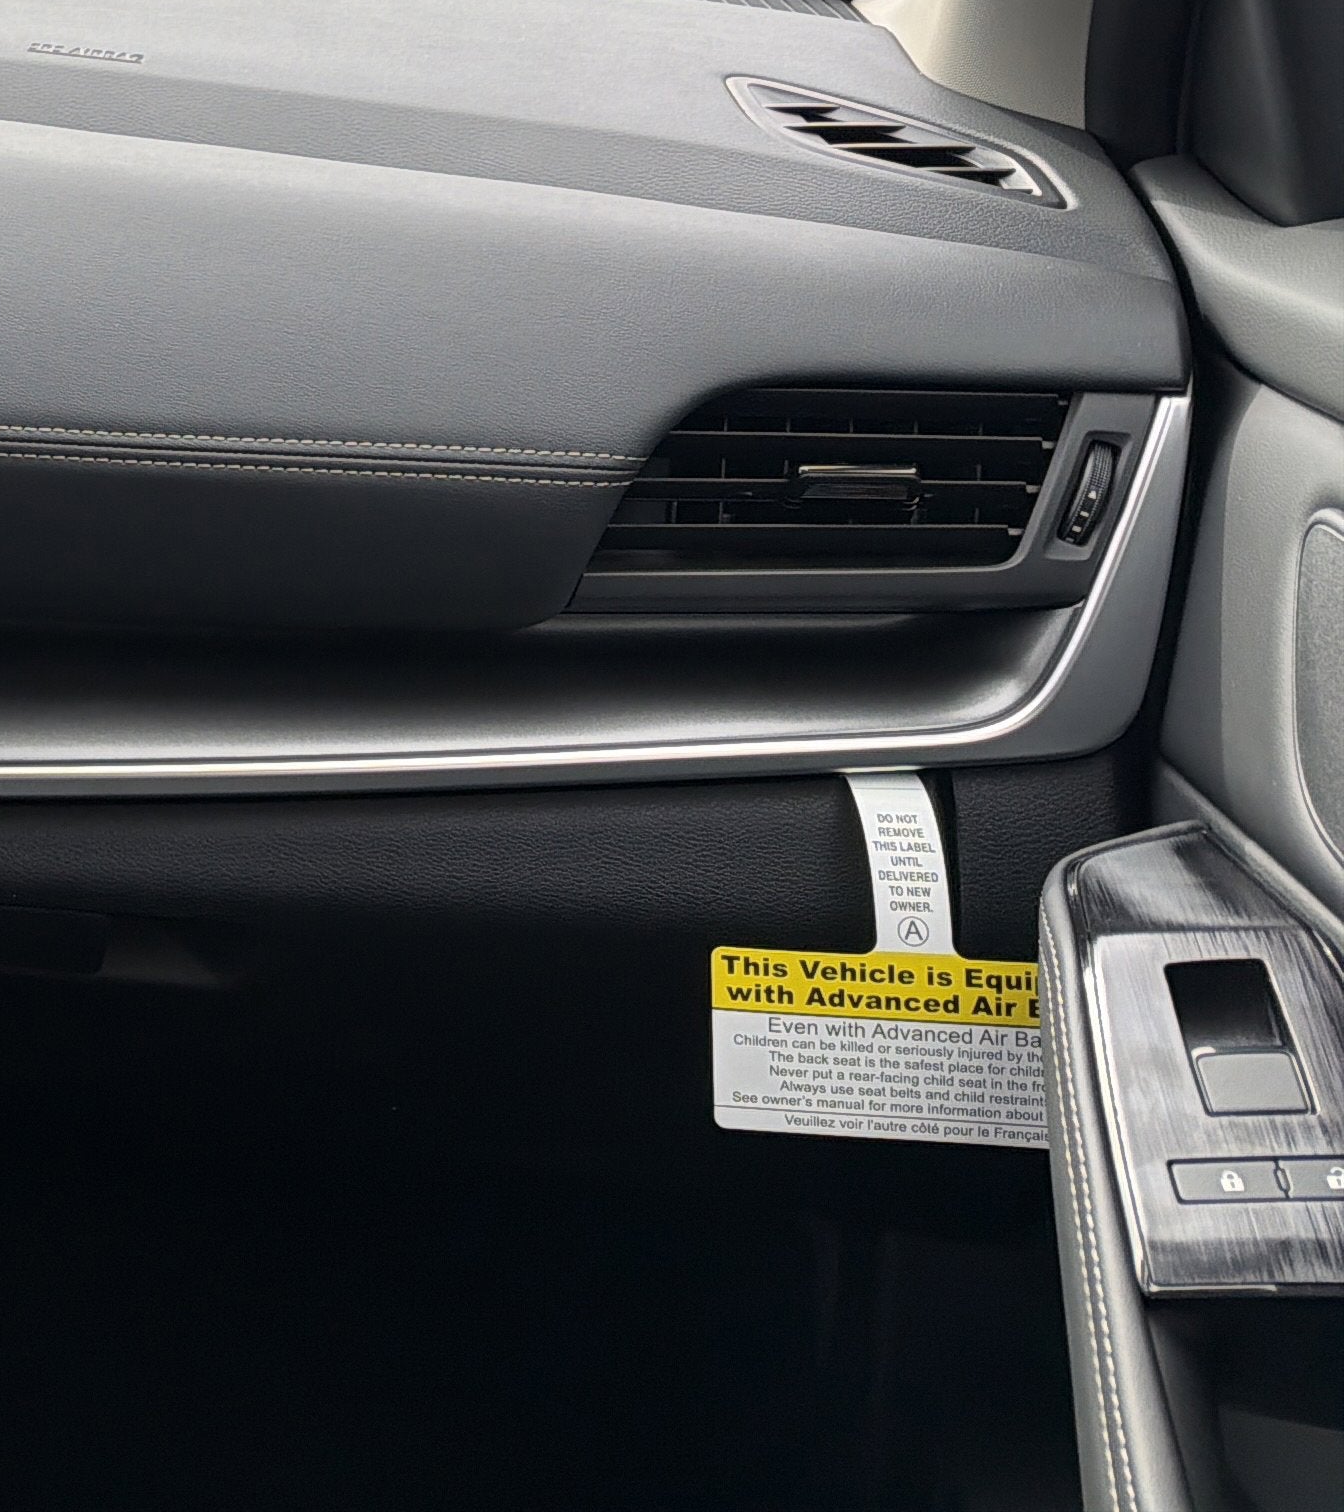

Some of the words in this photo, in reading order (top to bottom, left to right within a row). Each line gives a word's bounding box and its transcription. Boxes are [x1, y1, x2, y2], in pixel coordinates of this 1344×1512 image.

[876, 813, 893, 824] DO
[895, 814, 918, 825] NOT
[878, 827, 925, 839] REMOVE
[873, 840, 898, 852] THIS
[899, 841, 937, 854] LABEL
[890, 856, 923, 868] UNTIL
[878, 870, 939, 883] DELIVERED
[889, 885, 904, 897] TO
[906, 886, 932, 898] NEW
[889, 900, 934, 913] OWNER.
[904, 920, 924, 941] A
[721, 954, 789, 978] This
[799, 959, 916, 985] Vehicle
[927, 966, 953, 987] is
[726, 983, 794, 1005] with
[805, 987, 960, 1015] Advanced
[971, 996, 1018, 1017] Air
[768, 1016, 819, 1036] Even
[825, 1021, 866, 1039] with
[872, 1023, 973, 1045] Advanced
[979, 1029, 1009, 1047] Air
[733, 1033, 788, 1048] Children
[791, 1039, 816, 1050] can
[819, 1040, 837, 1051] be
[840, 1040, 874, 1054] killed
[877, 1044, 892, 1054] or
[895, 1045, 955, 1061] seriously
[957, 1048, 1003, 1062] injured
[1007, 1049, 1024, 1065] by
[769, 1050, 795, 1064] The
[798, 1052, 830, 1066] back
[832, 1055, 862, 1068] seat
[864, 1057, 876, 1069] is
[879, 1058, 901, 1070] the
[904, 1059, 945, 1072] safest
[948, 1063, 984, 1075] place
[987, 1063, 1007, 1076] for
[769, 1065, 809, 1078] Never
[812, 1069, 833, 1082] put
[836, 1071, 845, 1081] a
[848, 1072, 920, 1088] rear-facing
[923, 1075, 955, 1087] child
[958, 1078, 987, 1089] seat
[990, 1079, 1003, 1090] in
[1006, 1080, 1028, 1092] the
[780, 1080, 827, 1096] Always
[830, 1086, 854, 1096] use
[858, 1086, 887, 1098] seat
[890, 1088, 922, 1099] belts
[925, 1090, 950, 1102] and
[953, 1092, 985, 1104] child
[732, 1091, 759, 1104] See
[761, 1094, 813, 1108] owner's
[816, 1097, 865, 1111] manual
[868, 1099, 887, 1112] for
[890, 1103, 924, 1114] more
[927, 1104, 1002, 1119] information
[1005, 1109, 1044, 1122] about
[784, 1113, 836, 1129] Veuillez
[838, 1119, 864, 1130] voir
[867, 1120, 907, 1132] l'autre
[910, 1121, 940, 1135] côté
[943, 1126, 974, 1138] pour
[977, 1125, 990, 1138] le
